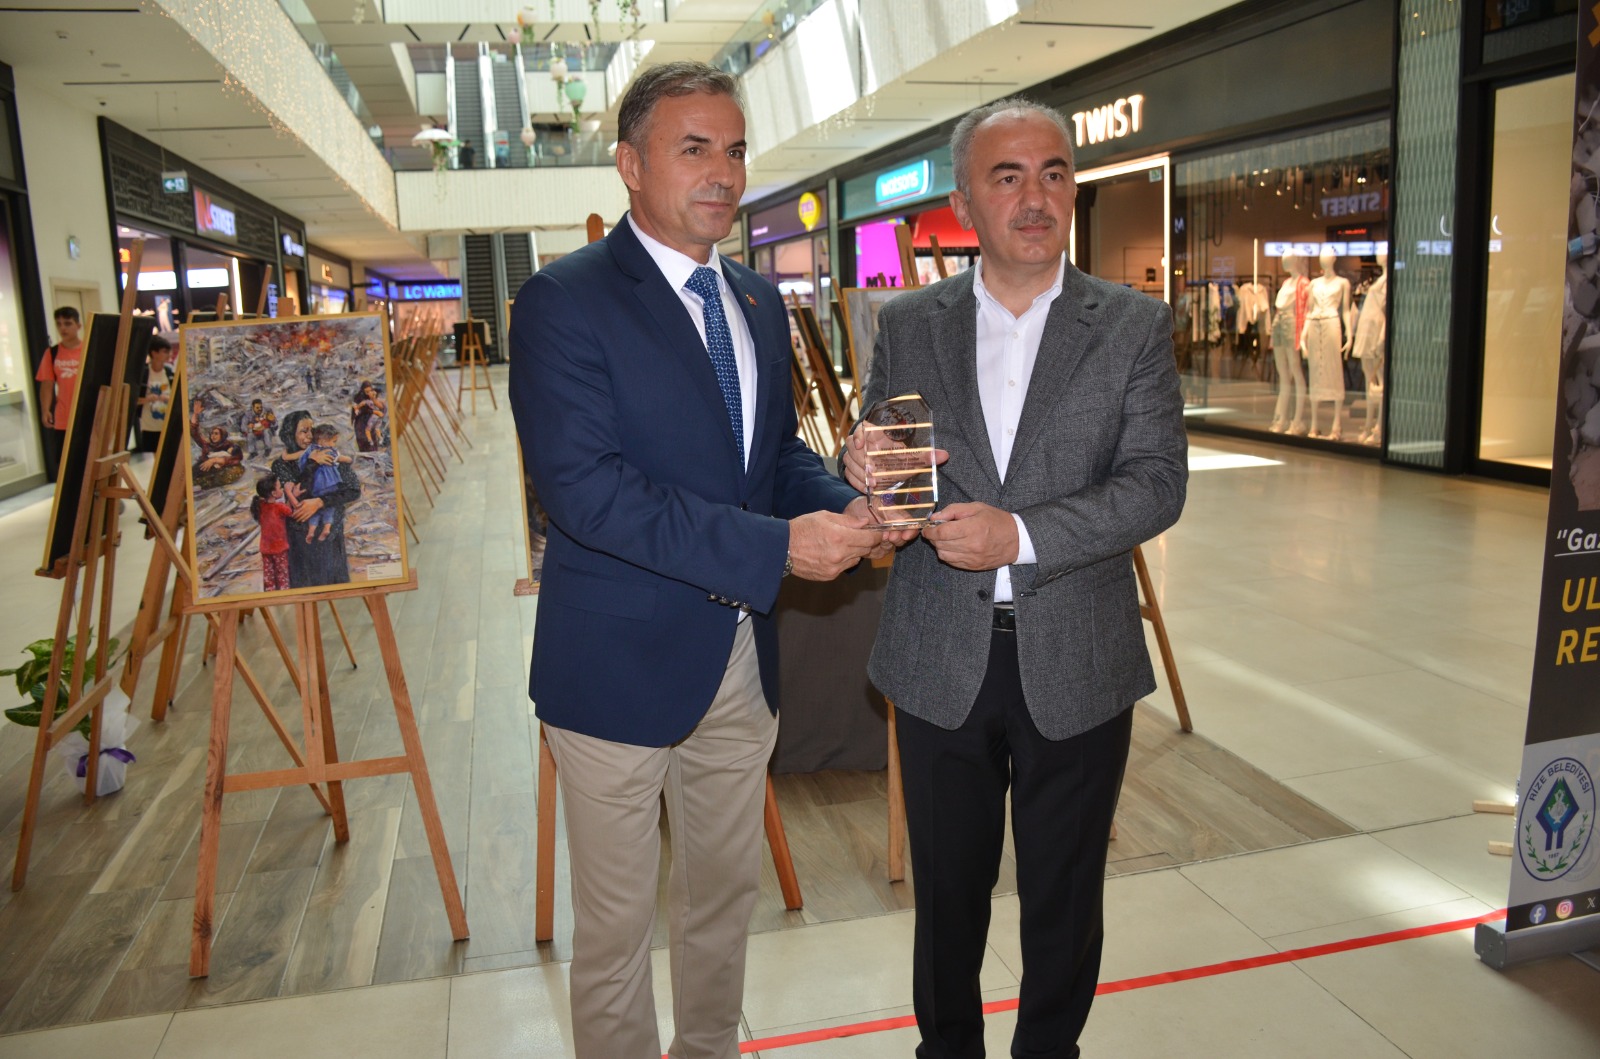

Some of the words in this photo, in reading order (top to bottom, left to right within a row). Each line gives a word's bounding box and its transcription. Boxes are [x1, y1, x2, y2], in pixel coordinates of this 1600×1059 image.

[1071, 94, 1144, 147] TWIST
[880, 171, 918, 196] watsons
[404, 285, 422, 299] LC
[1529, 775, 1547, 801] RİZE
[1547, 763, 1592, 794] BELEDİYESİ
